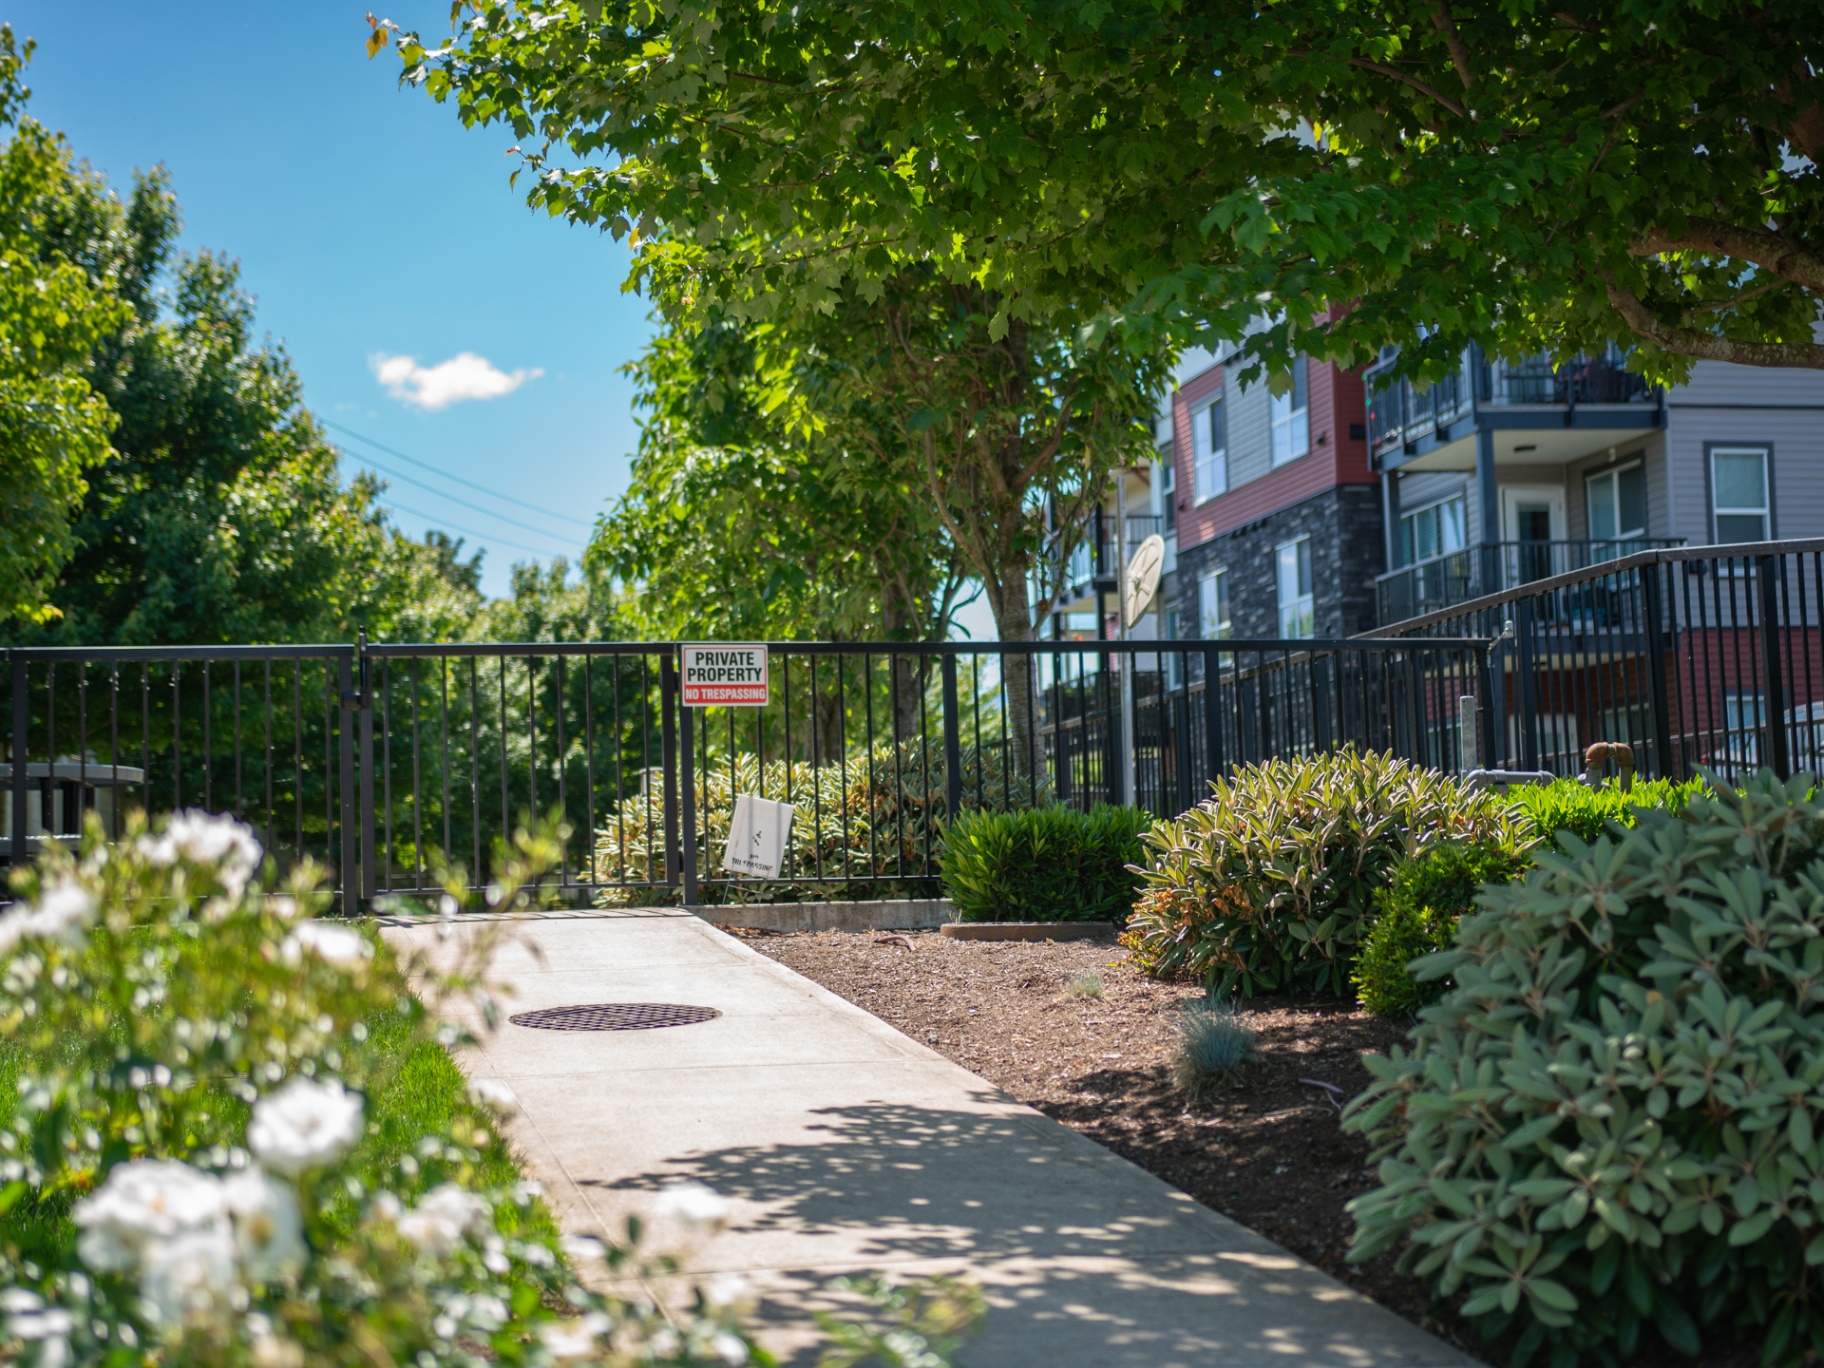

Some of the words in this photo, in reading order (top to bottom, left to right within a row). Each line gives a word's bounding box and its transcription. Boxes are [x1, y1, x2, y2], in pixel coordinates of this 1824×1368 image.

[695, 651, 755, 666] PRIVATE
[687, 667, 763, 682] PROPERTY
[685, 688, 699, 700] NO
[701, 688, 766, 700] TRESPASSING
